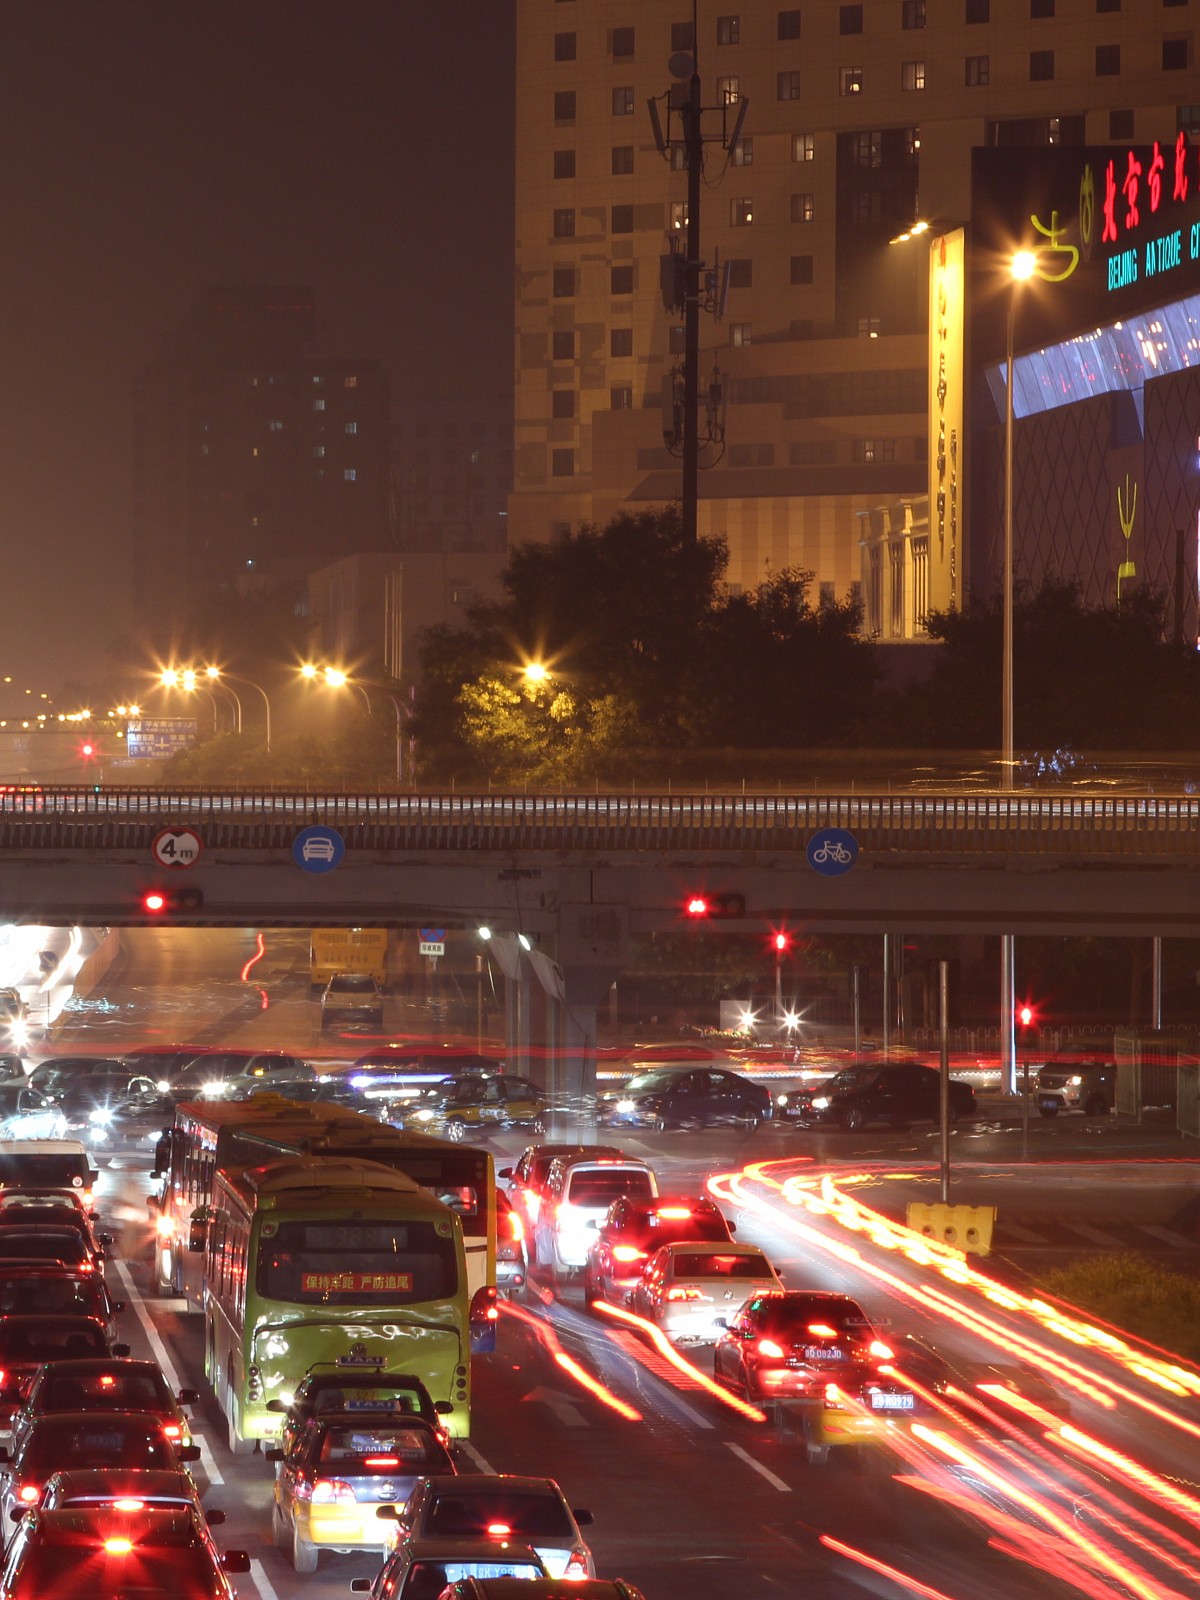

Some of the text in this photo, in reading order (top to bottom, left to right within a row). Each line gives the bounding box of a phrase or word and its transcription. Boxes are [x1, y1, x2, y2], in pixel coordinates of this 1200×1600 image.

[1102, 131, 1200, 243] 北京古玩
[1108, 249, 1138, 291] BEIJING
[1145, 229, 1181, 276] ANTIQUE
[306, 1275, 409, 1290] 保持车距 严防追尾
[346, 1356, 381, 1364] TAXI
[355, 1400, 392, 1408] TAXI
